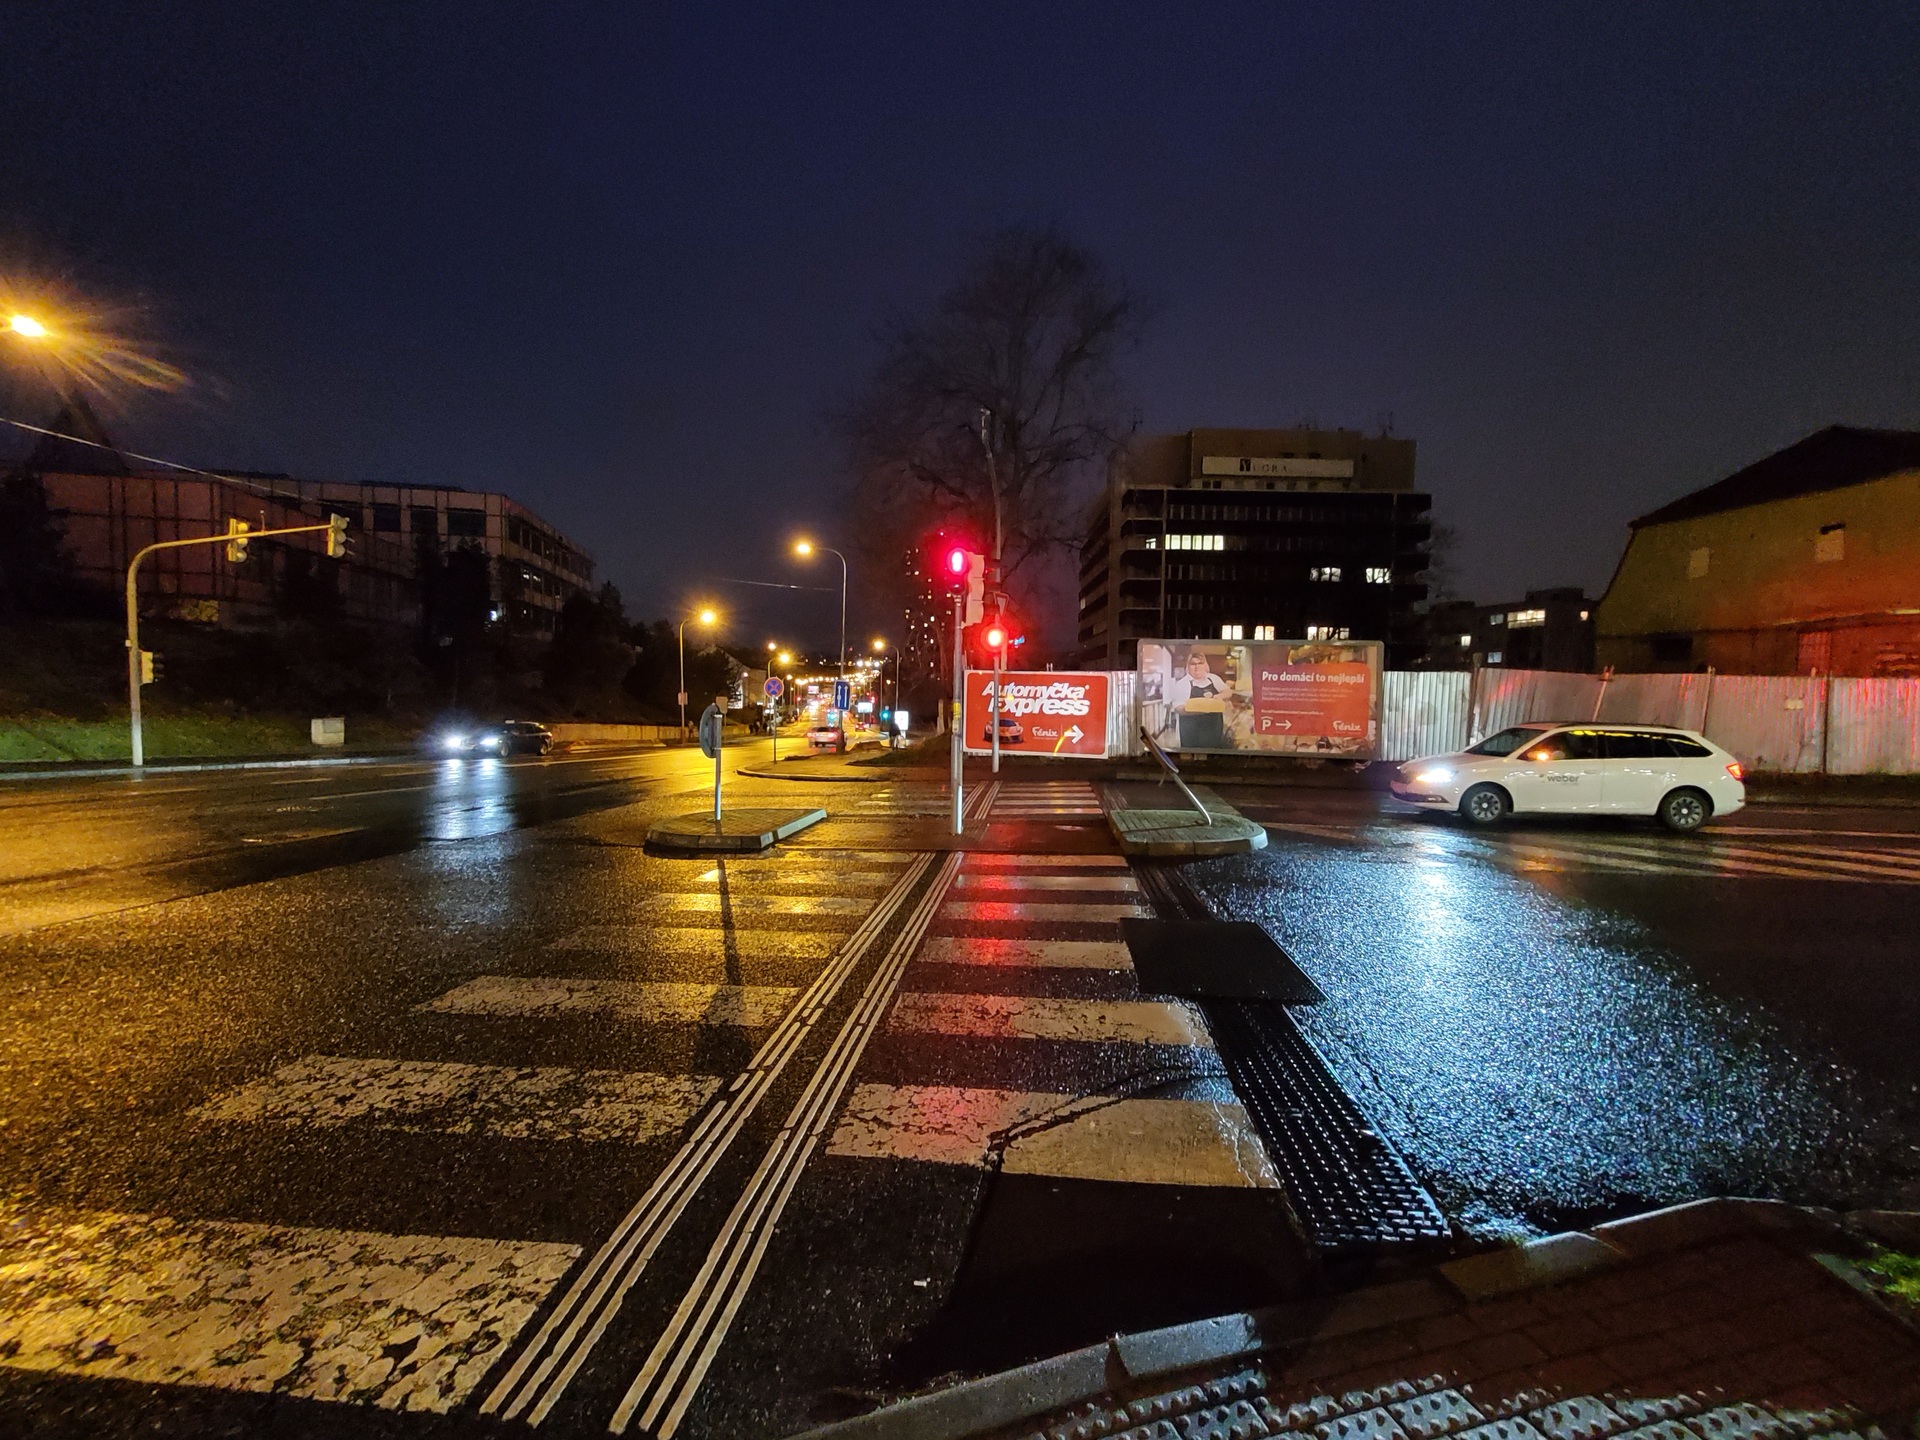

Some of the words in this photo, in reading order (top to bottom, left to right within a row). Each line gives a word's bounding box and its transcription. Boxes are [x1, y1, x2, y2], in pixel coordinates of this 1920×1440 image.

[1262, 671, 1278, 681] Pro
[1280, 671, 1315, 682] domácí
[1316, 674, 1326, 683] to
[1327, 674, 1365, 685] nejlepší
[982, 681, 1086, 699] Automyčka
[988, 696, 1091, 717] Express
[1547, 775, 1580, 783] weber
